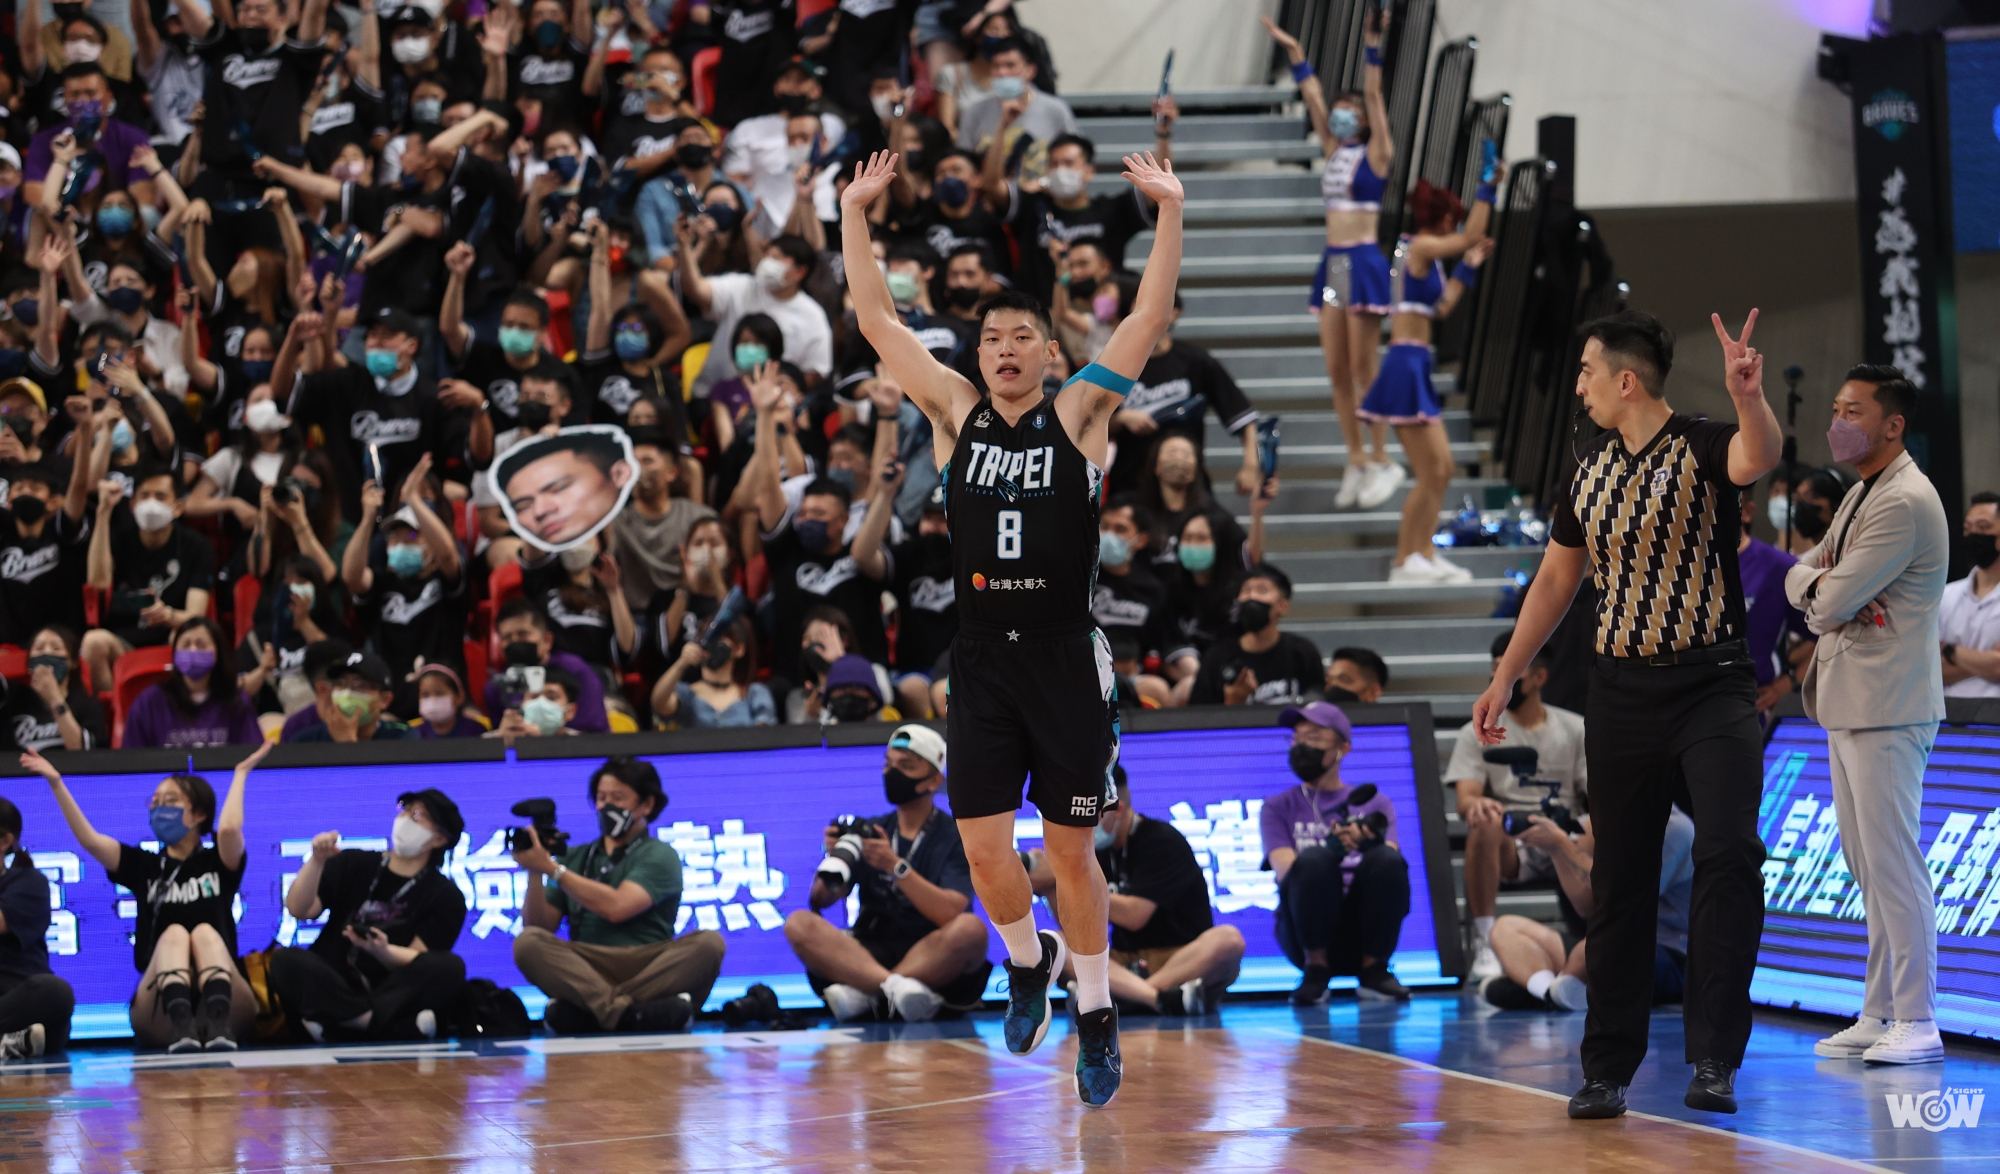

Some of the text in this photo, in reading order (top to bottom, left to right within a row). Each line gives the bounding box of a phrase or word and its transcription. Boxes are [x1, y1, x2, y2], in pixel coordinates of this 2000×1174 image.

[965, 441, 1054, 489] TAIPEI
[995, 510, 1021, 560] 8
[989, 577, 1046, 592] 台灣大哥大
